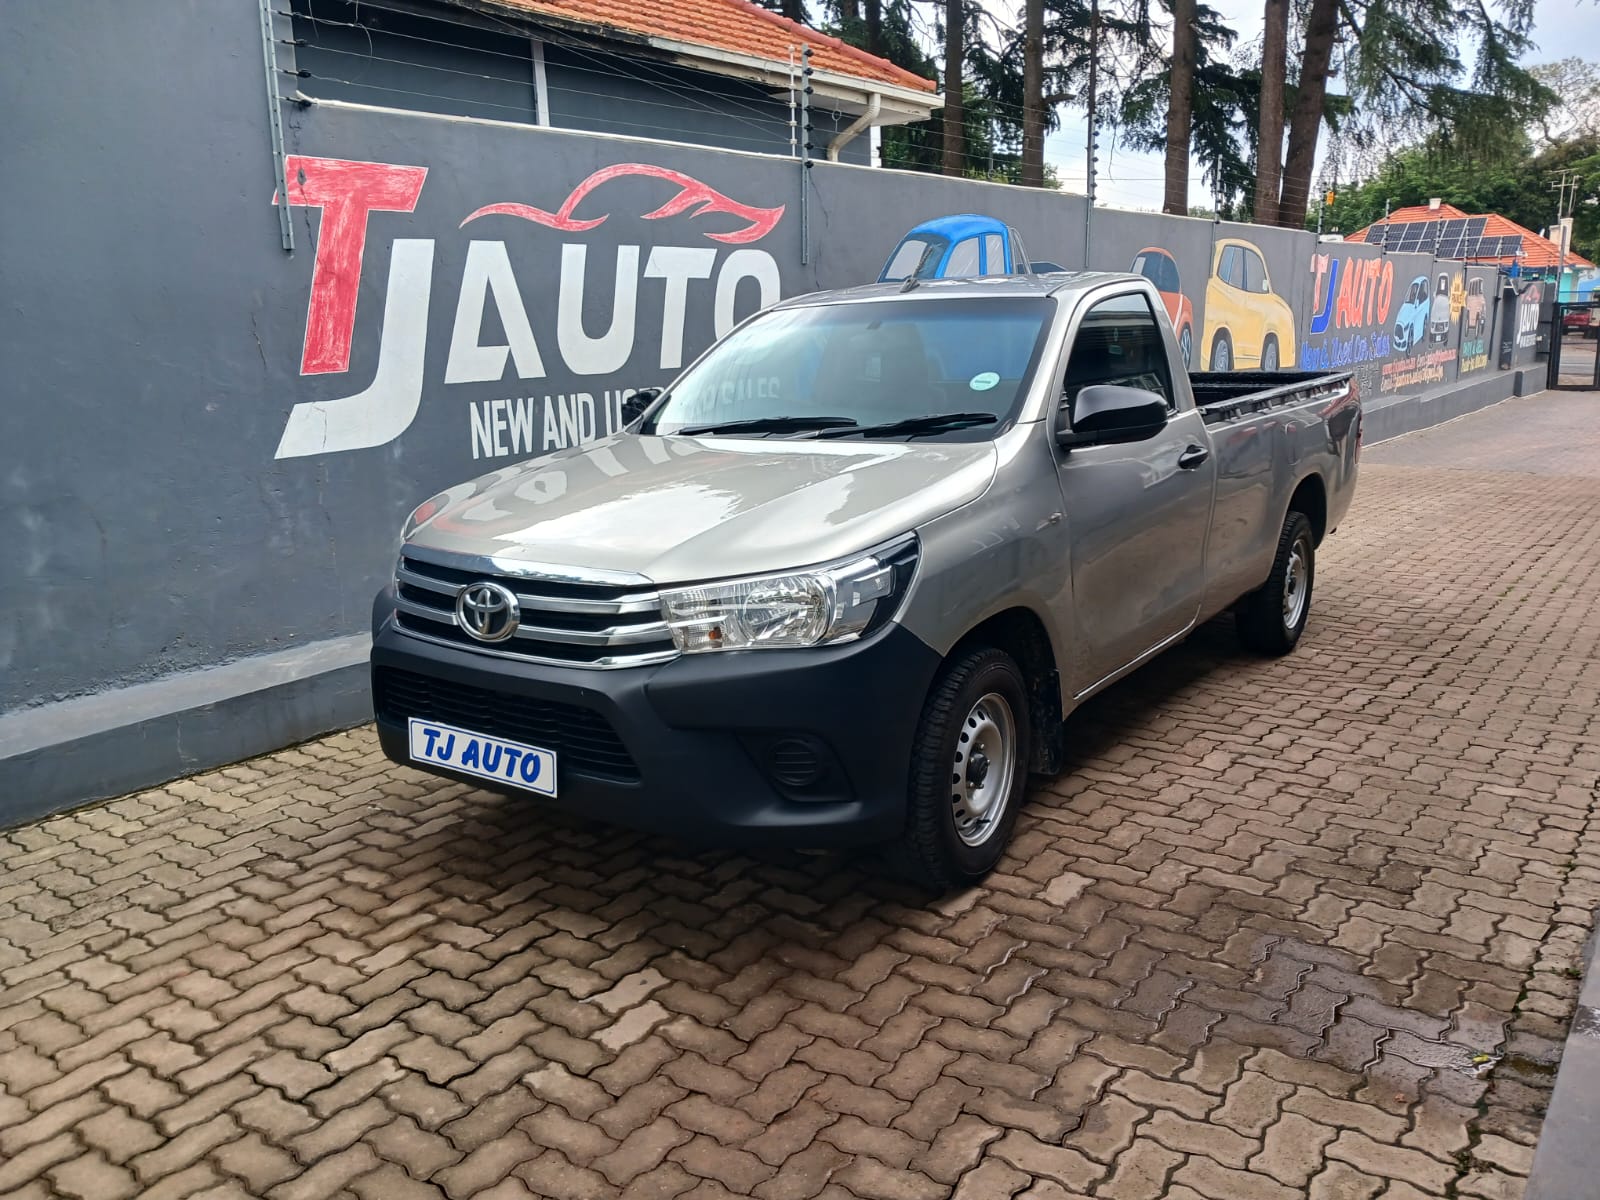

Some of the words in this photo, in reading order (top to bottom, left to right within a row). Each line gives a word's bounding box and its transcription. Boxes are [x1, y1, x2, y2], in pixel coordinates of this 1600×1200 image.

[272, 155, 435, 459] TJ
[444, 240, 781, 384] AUTO
[1336, 256, 1393, 329] AUTO
[470, 397, 534, 460] NEW
[543, 392, 595, 451] AND
[423, 728, 455, 761] TJ
[461, 739, 541, 783] AUTO
